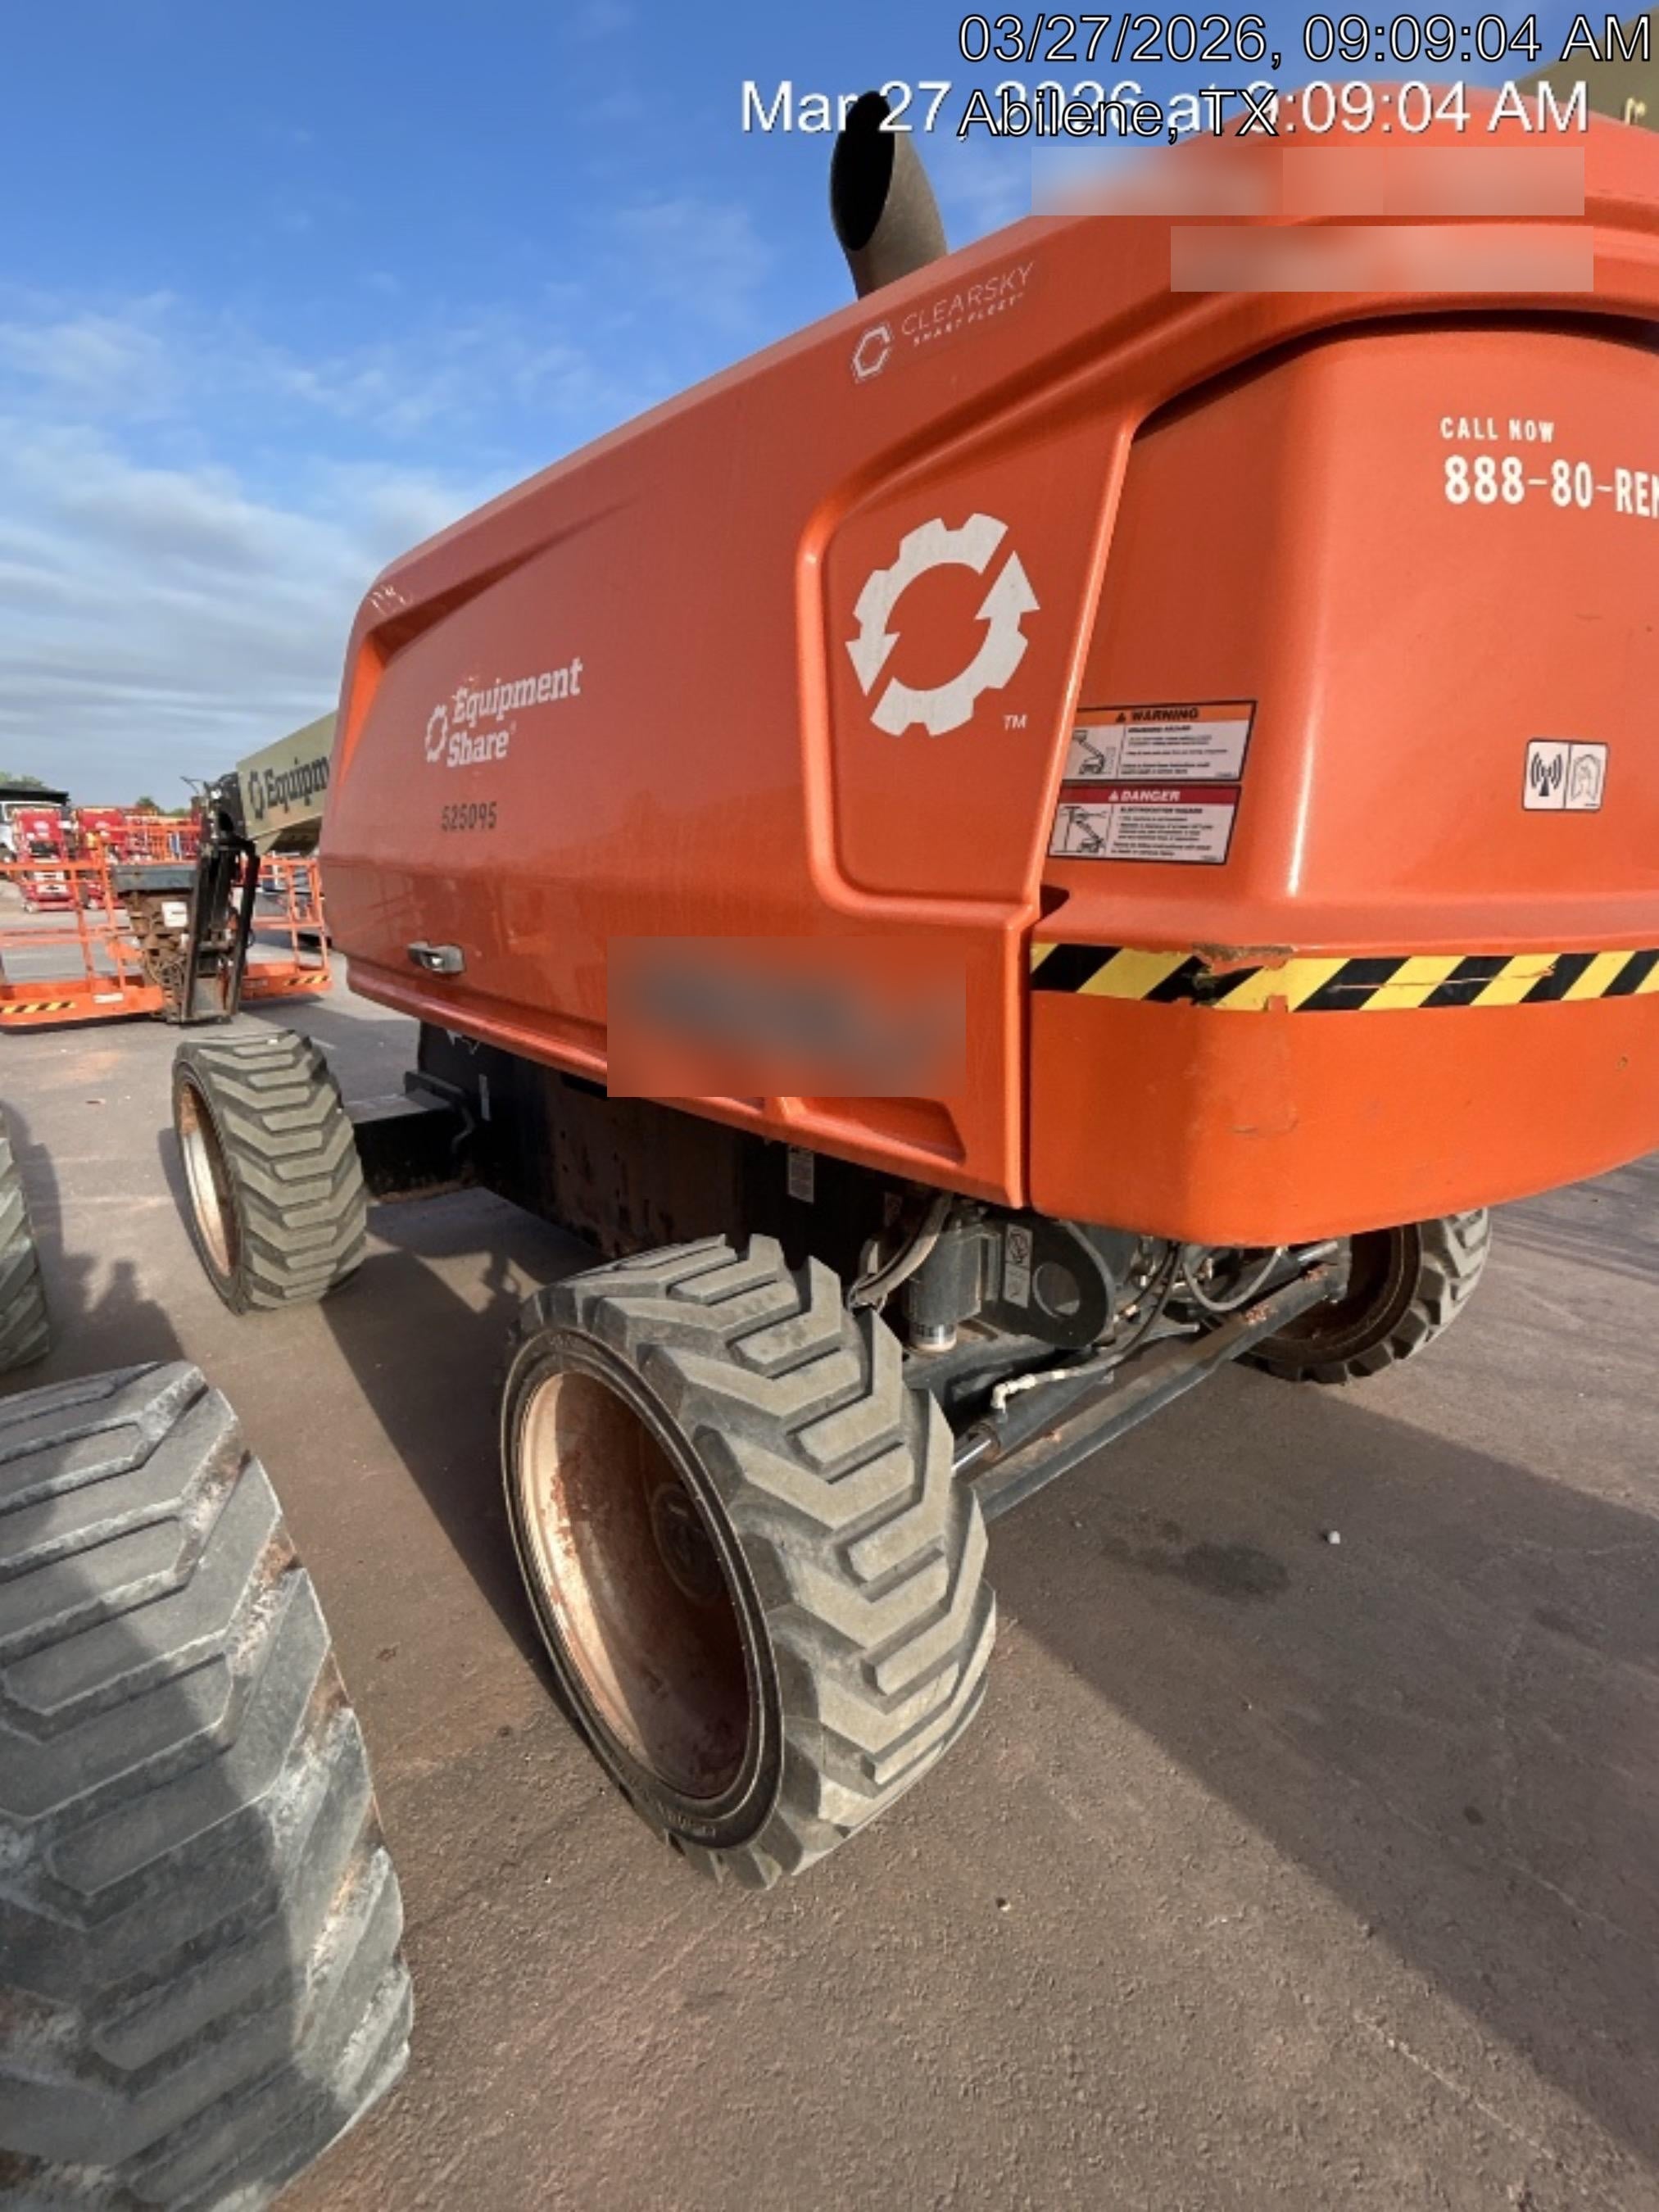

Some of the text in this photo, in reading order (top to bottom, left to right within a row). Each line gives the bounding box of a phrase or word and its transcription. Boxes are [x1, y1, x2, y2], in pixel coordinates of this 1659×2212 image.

[901, 261, 1036, 336] CLEARSKY
[1440, 416, 1554, 443] CALL NOW
[451, 656, 583, 728] Equipment
[1003, 714, 1027, 731] TM
[1131, 707, 1200, 722] WARNING
[446, 730, 510, 768] Share
[1120, 790, 1181, 802] DANGER
[441, 800, 497, 832] 525095
